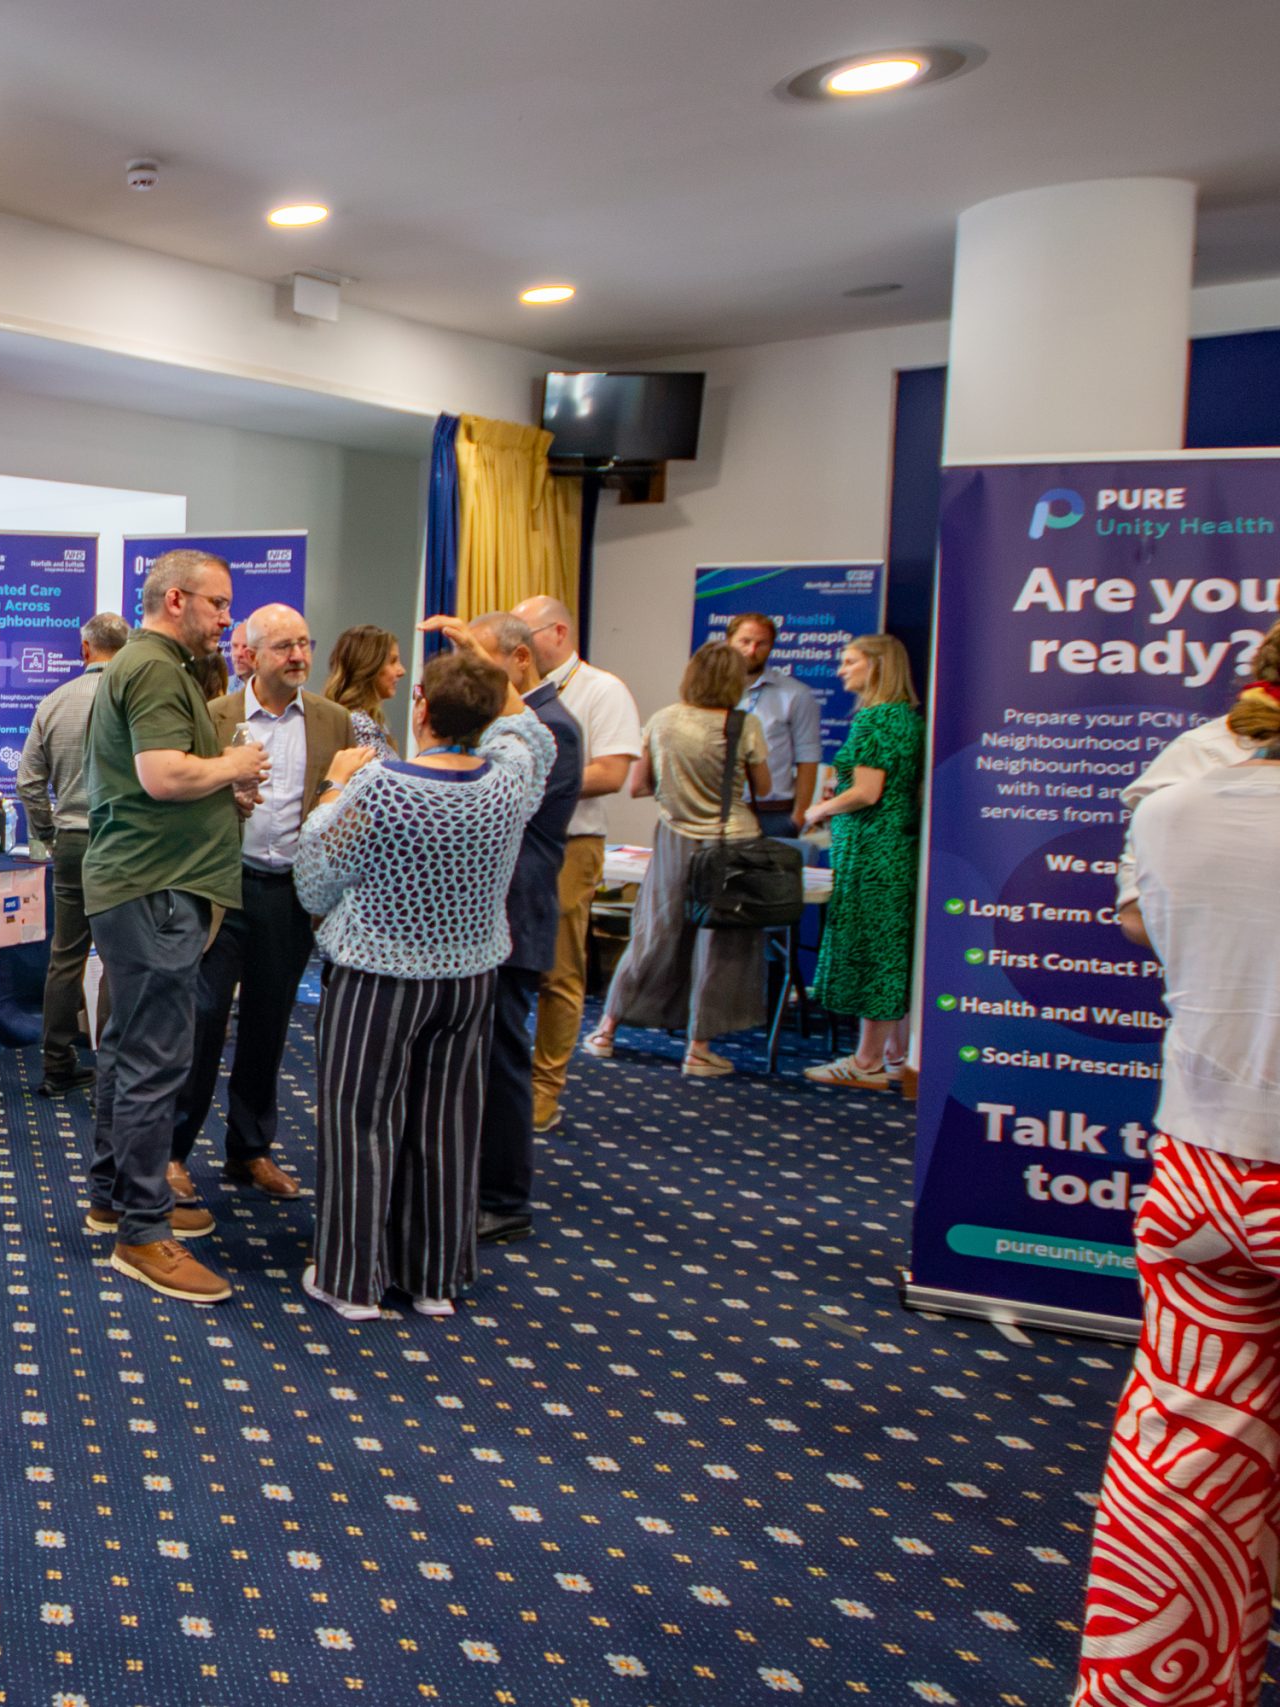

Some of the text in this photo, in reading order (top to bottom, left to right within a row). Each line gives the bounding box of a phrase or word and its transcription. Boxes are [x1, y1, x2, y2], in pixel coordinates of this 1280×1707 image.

[1097, 488, 1186, 510] PURE
[1096, 517, 1274, 539] Unity Health
[266, 549, 291, 560] NHS
[30, 584, 61, 596] Care
[1013, 567, 1280, 624] Are you
[5, 599, 51, 612] Across
[786, 613, 836, 626] health
[798, 630, 853, 645] people
[47, 659, 84, 667] Community
[1029, 629, 1265, 688] ready?
[1004, 708, 1081, 727] Prepare
[1085, 713, 1134, 729] your
[1138, 711, 1183, 728] PCN
[981, 732, 1141, 752] Neighbourhood
[976, 756, 1135, 776] Neighbourhood
[997, 781, 1040, 796] with
[1046, 782, 1093, 799] tried
[981, 805, 1059, 822] services
[1064, 806, 1114, 824] from
[1045, 853, 1087, 873] We
[969, 899, 1024, 923] Long
[1028, 902, 1091, 923] Term
[988, 949, 1038, 969] First
[1043, 953, 1138, 977] Contact
[959, 996, 1036, 1018] Health
[1041, 1006, 1087, 1022] and
[981, 1047, 1050, 1069] Social
[977, 1102, 1108, 1155] Talk
[1023, 1164, 1150, 1211] toda
